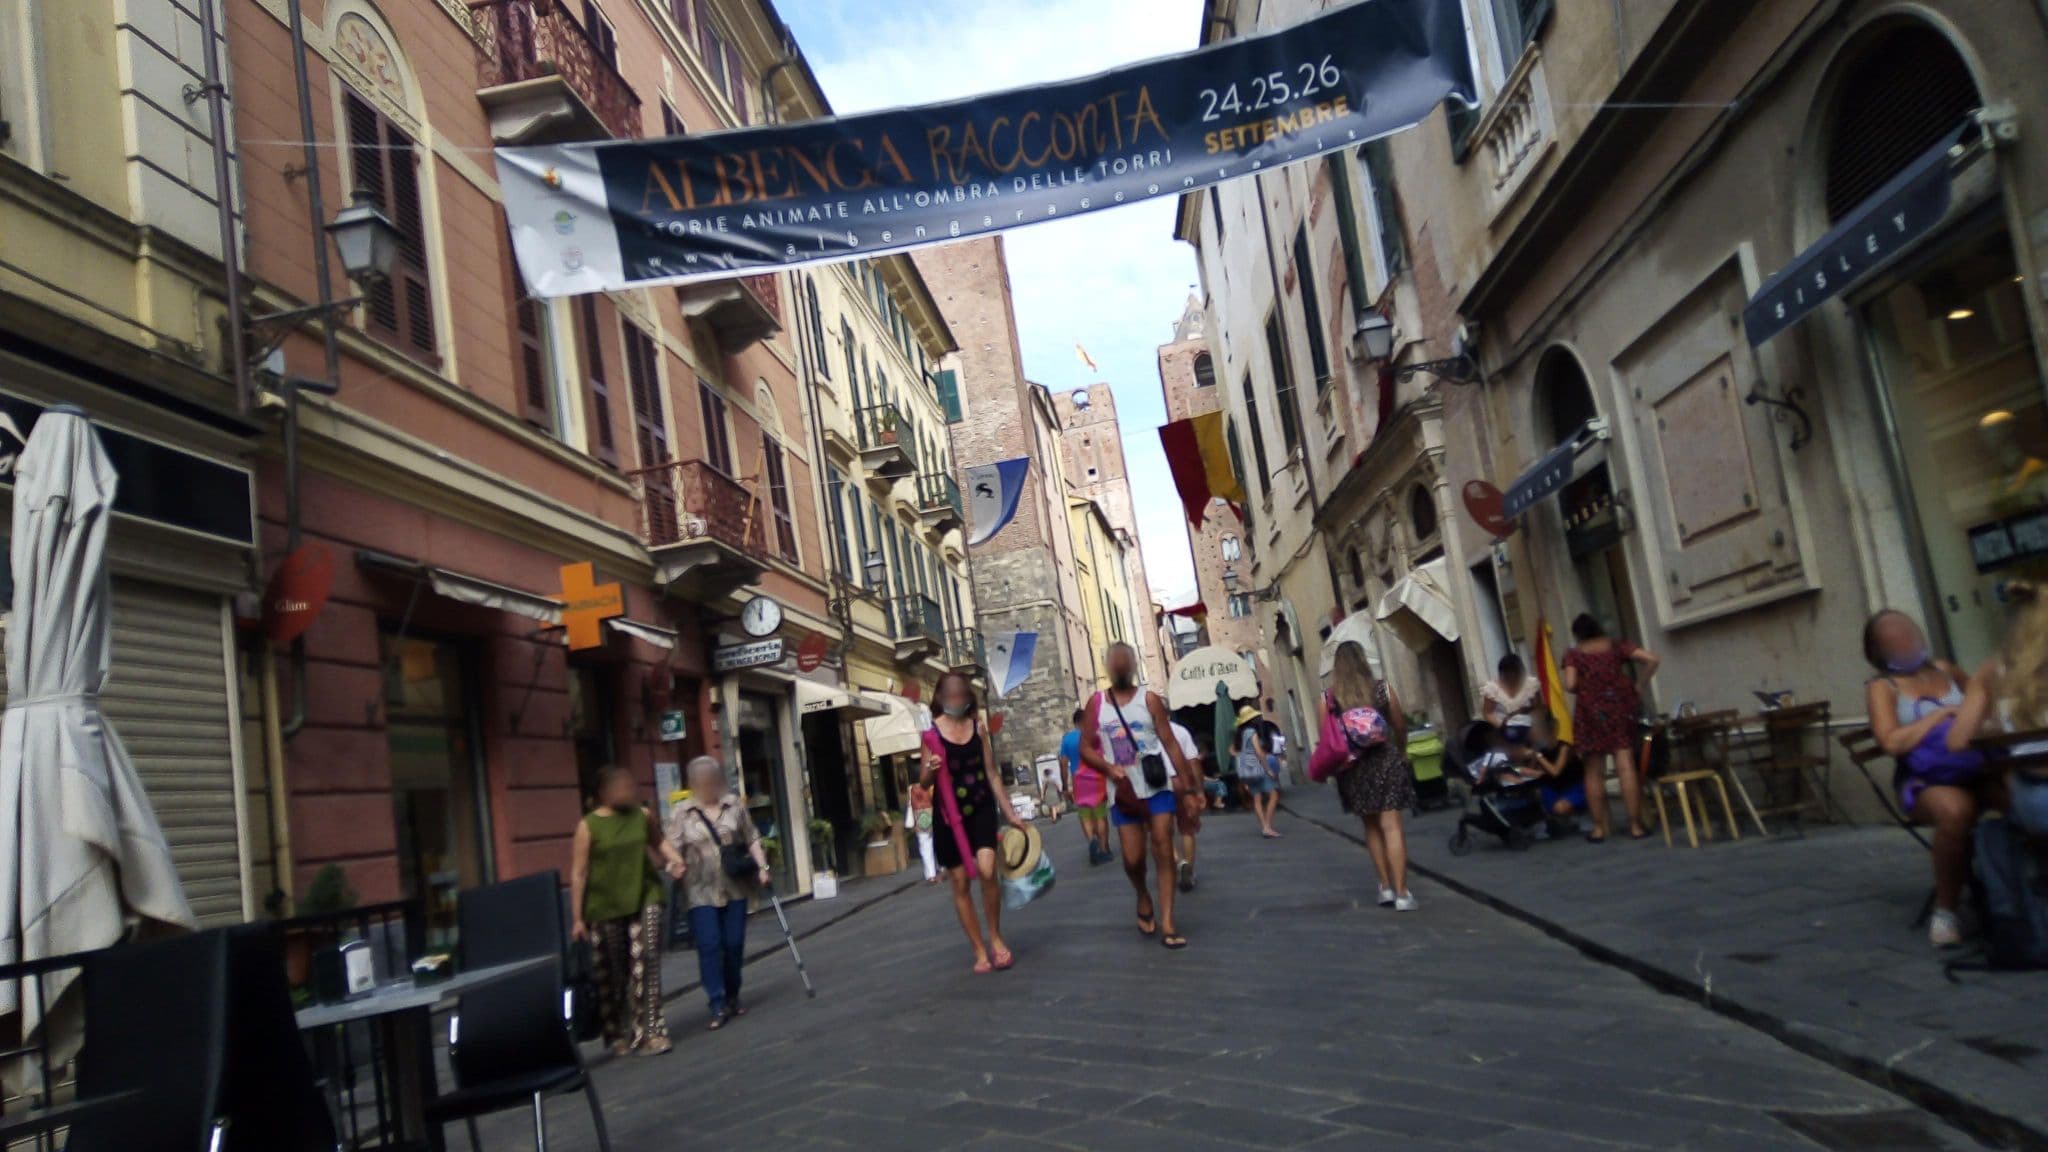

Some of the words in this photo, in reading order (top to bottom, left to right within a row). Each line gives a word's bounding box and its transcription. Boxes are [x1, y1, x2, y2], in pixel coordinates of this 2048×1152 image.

[1199, 54, 1341, 122] 24.25.26
[1204, 95, 1350, 155] SETTEMBRE
[640, 131, 917, 215] ALBENGA
[742, 201, 849, 229] ANIMATE
[863, 182, 1000, 215] ALL'OMBRA
[1012, 167, 1086, 193] DELLE
[1097, 148, 1173, 178] TORRI
[1775, 212, 1906, 319] SISLEY
